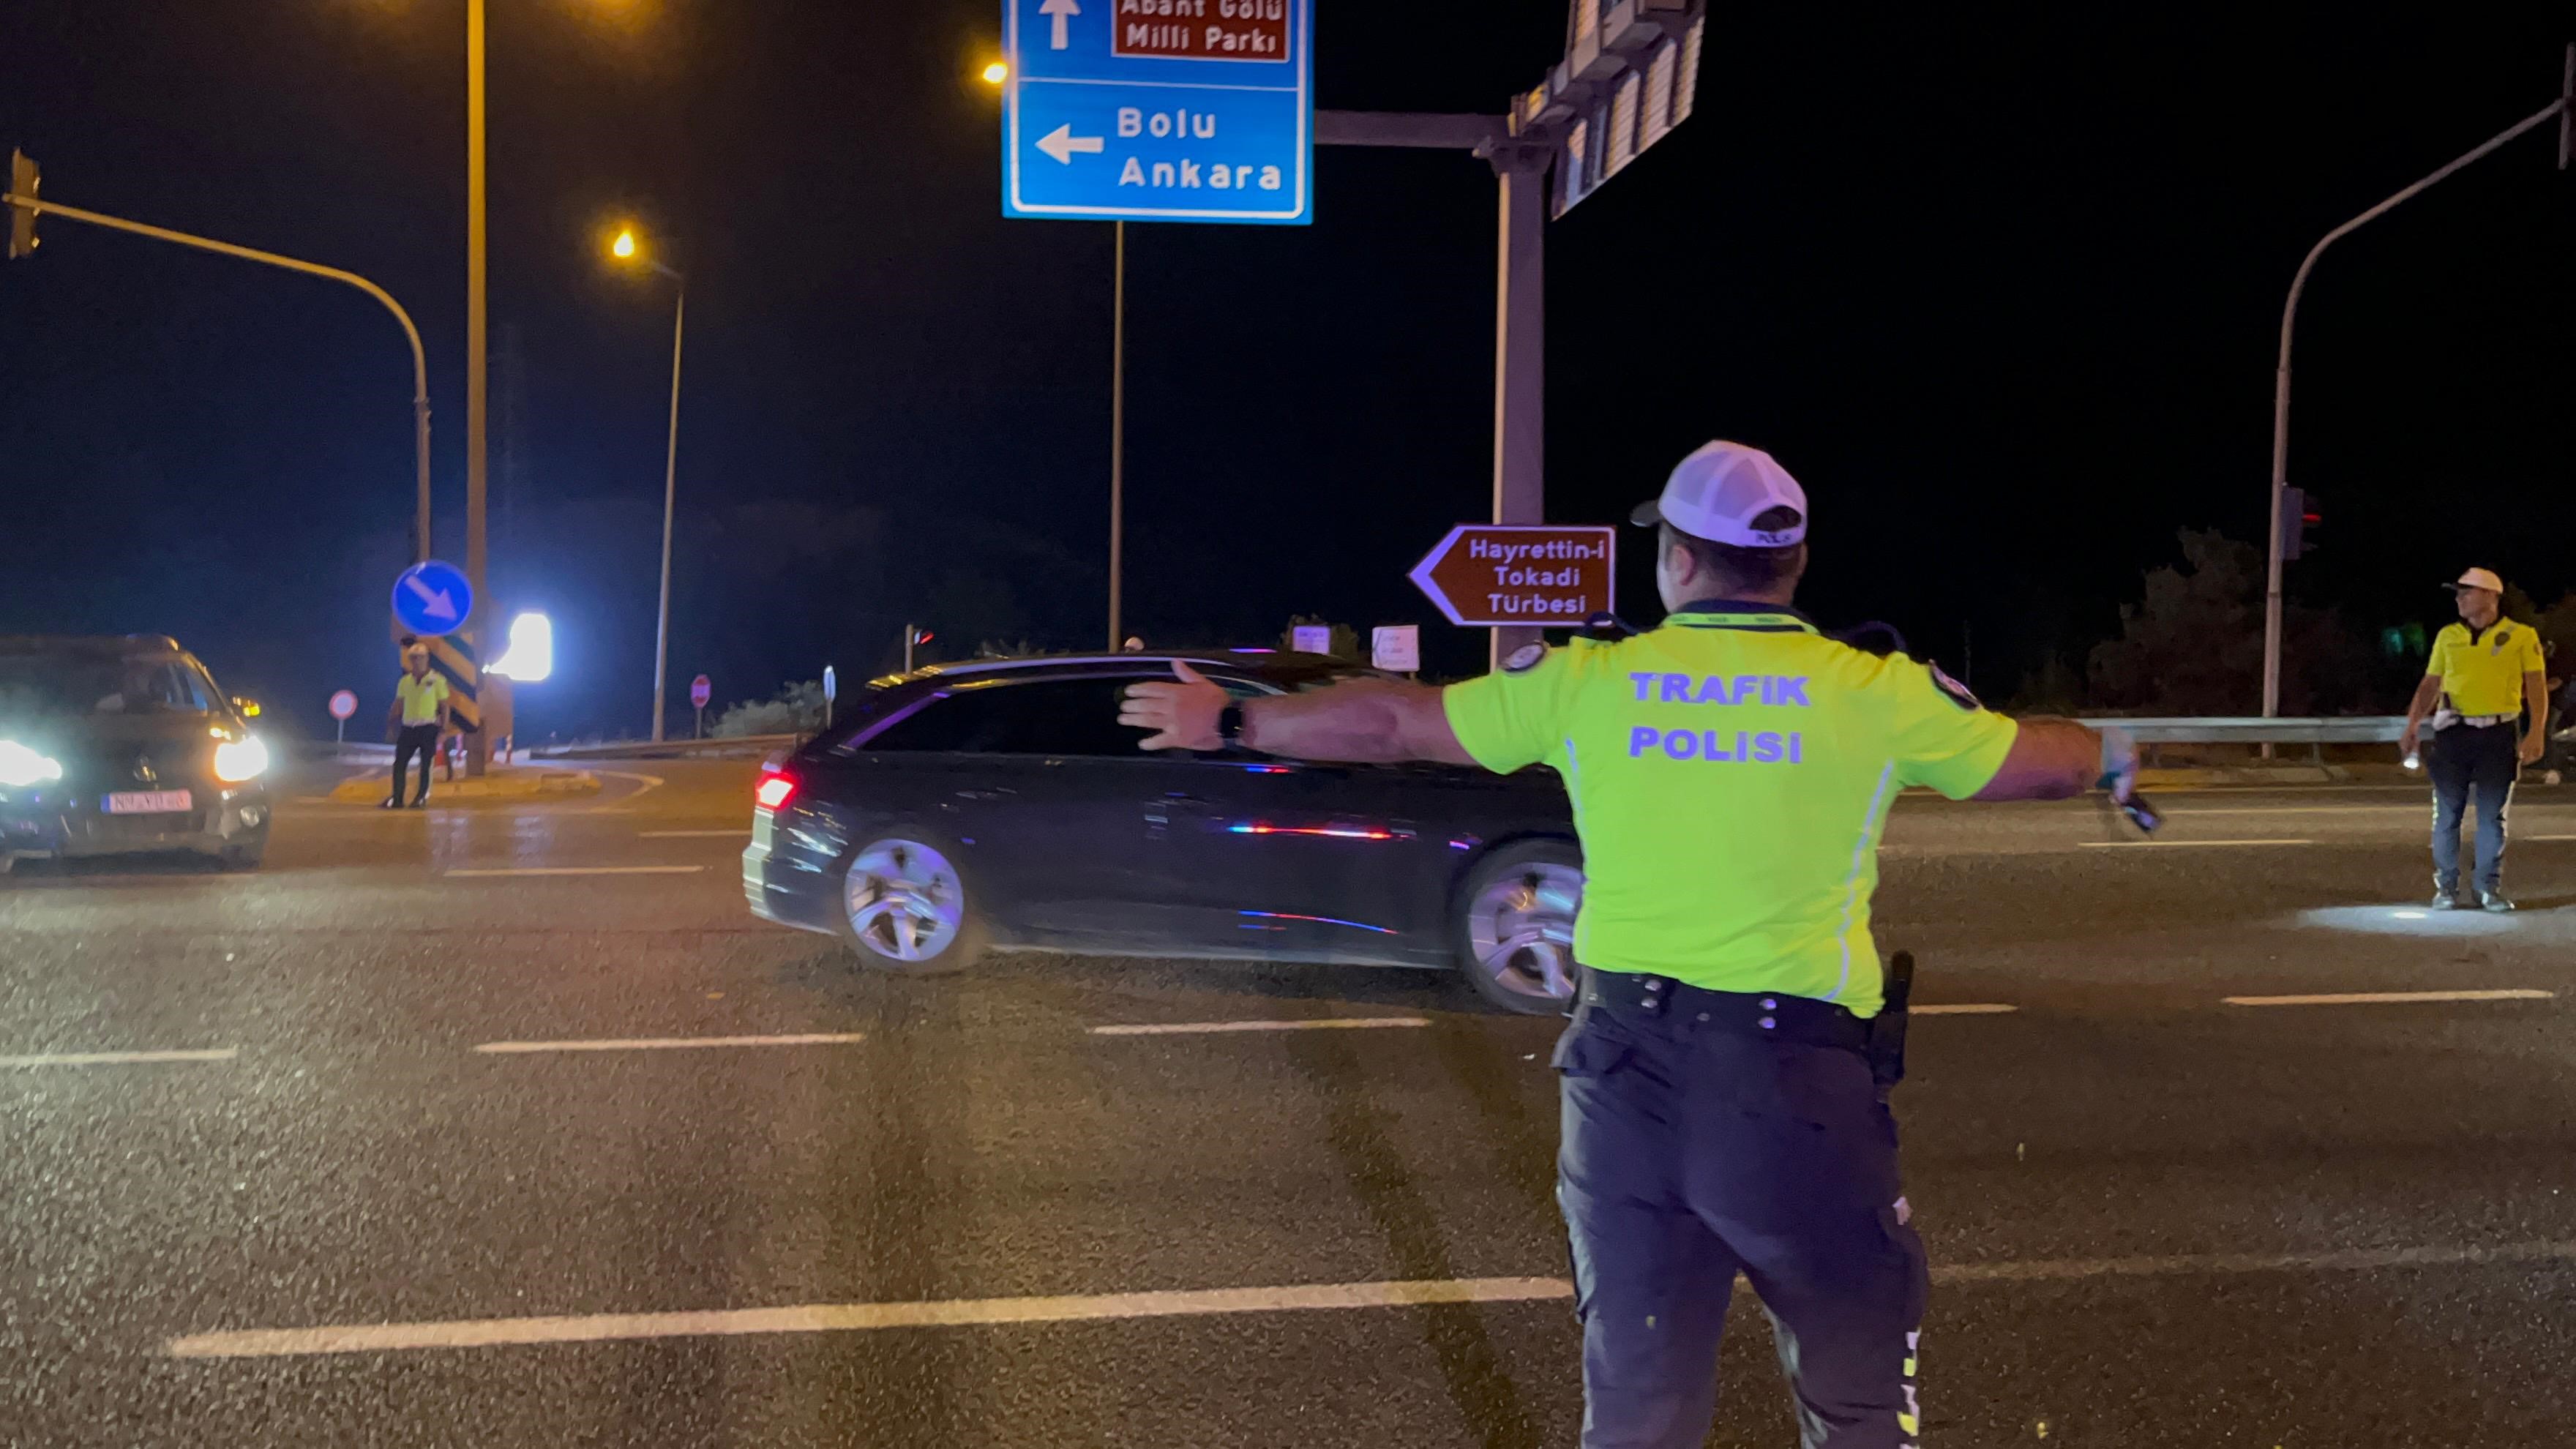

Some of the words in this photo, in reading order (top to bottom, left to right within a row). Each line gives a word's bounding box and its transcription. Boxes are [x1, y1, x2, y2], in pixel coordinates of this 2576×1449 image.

[1126, 23, 1190, 49] Milli
[1205, 26, 1276, 53] Parkı
[1117, 107, 1216, 139] Bolu
[1117, 156, 1282, 190] Ankara
[1469, 539, 1604, 564] Hayrettin-i
[1494, 566, 1581, 586] Tokadi
[1487, 594, 1587, 614] Türbesi
[1629, 672, 1811, 706] TRAFİK
[1629, 725, 1802, 764] POLİSİ
